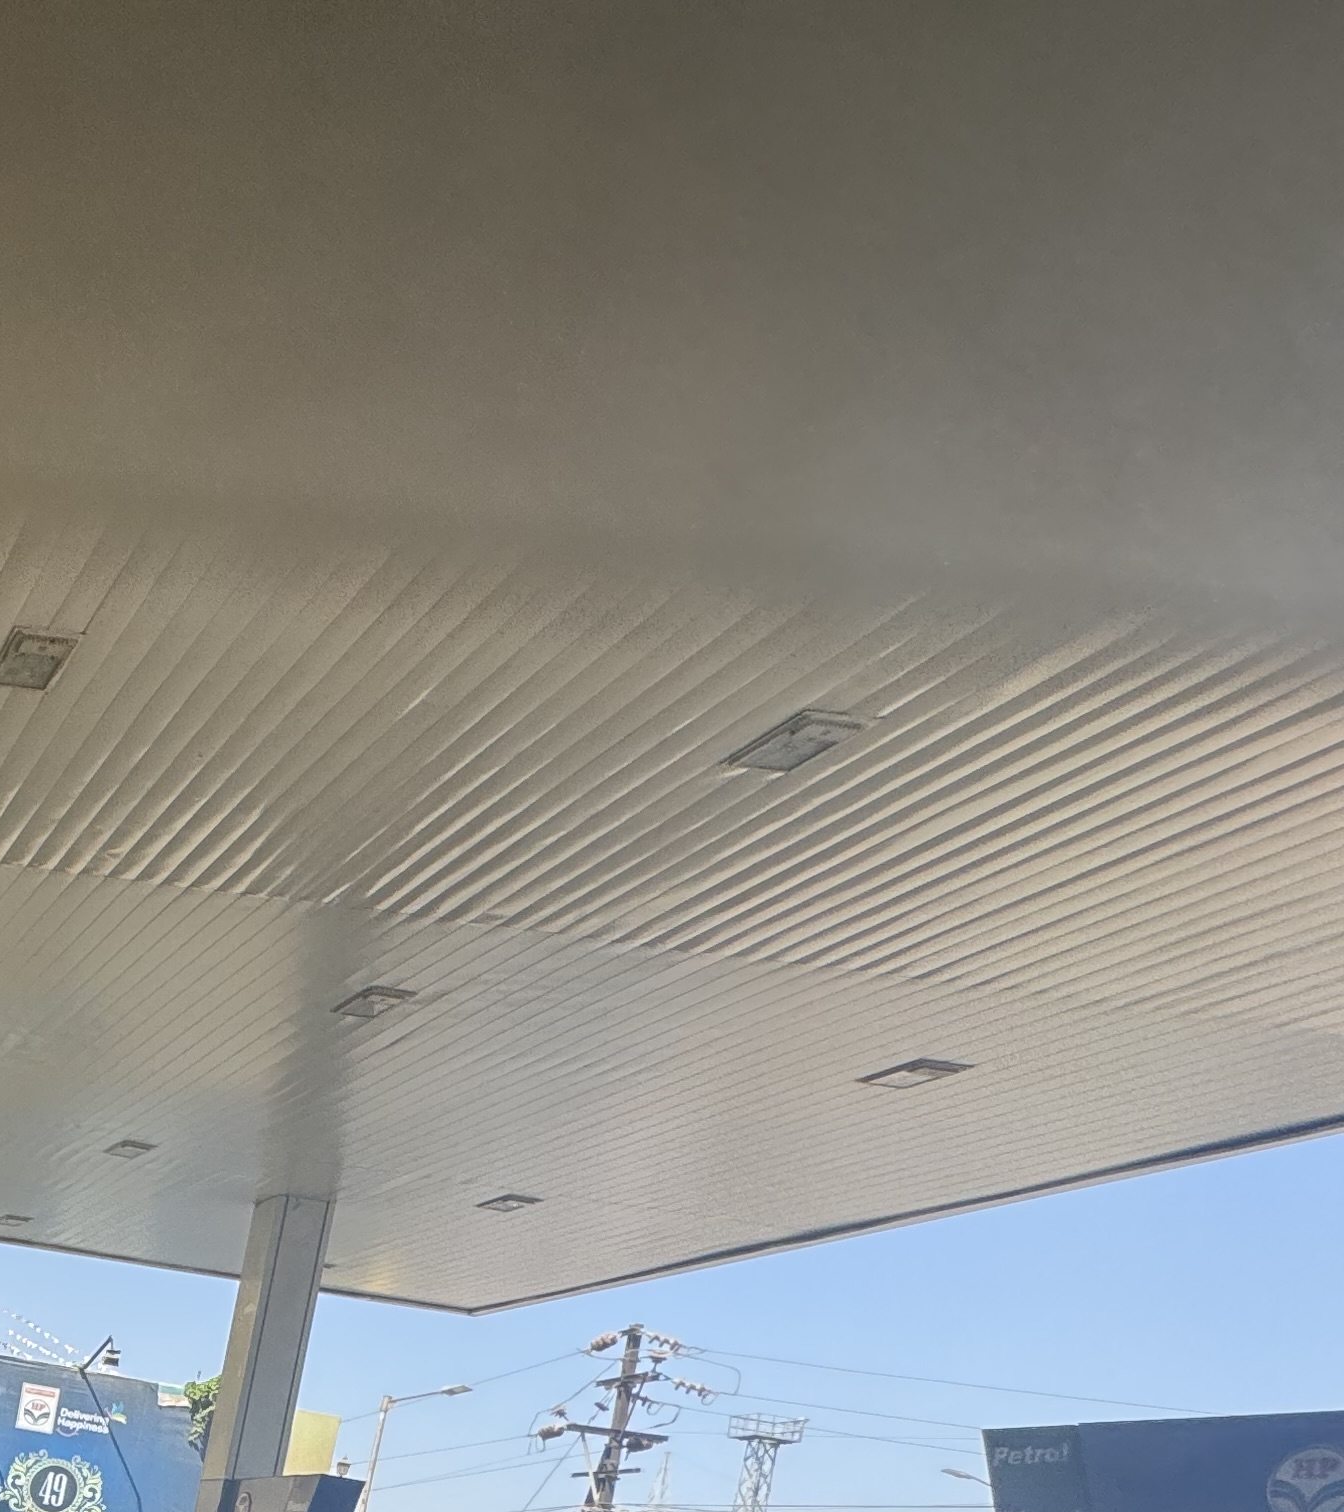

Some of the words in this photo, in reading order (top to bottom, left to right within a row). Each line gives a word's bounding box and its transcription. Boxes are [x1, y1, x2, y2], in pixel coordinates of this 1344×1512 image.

[60, 1406, 110, 1425] Delivering
[56, 1416, 110, 1435] Happiness
[38, 1471, 68, 1508] 49
